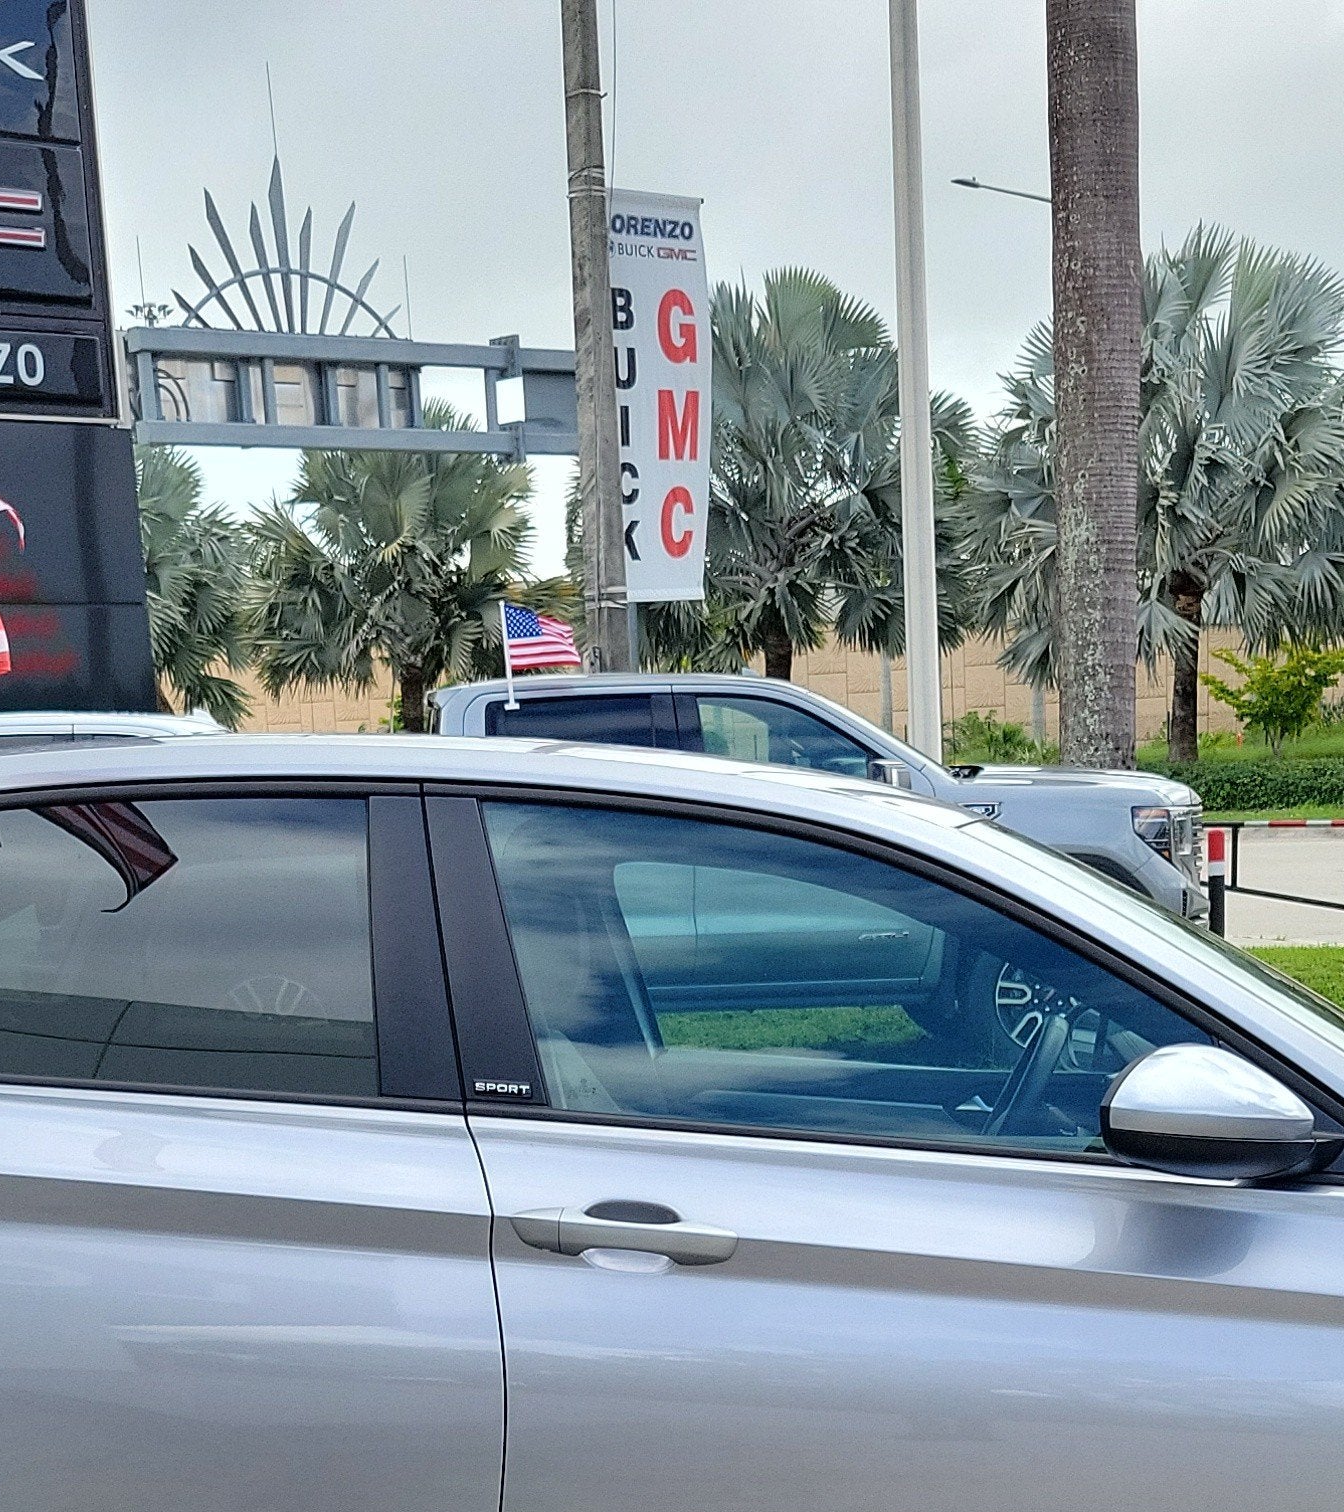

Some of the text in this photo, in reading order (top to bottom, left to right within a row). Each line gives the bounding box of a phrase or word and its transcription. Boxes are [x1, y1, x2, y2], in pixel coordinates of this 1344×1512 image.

[611, 214, 694, 240] ORENZO
[617, 242, 697, 261] BUICK GMC
[657, 288, 700, 558] GMC
[474, 1082, 530, 1095] SPORT
